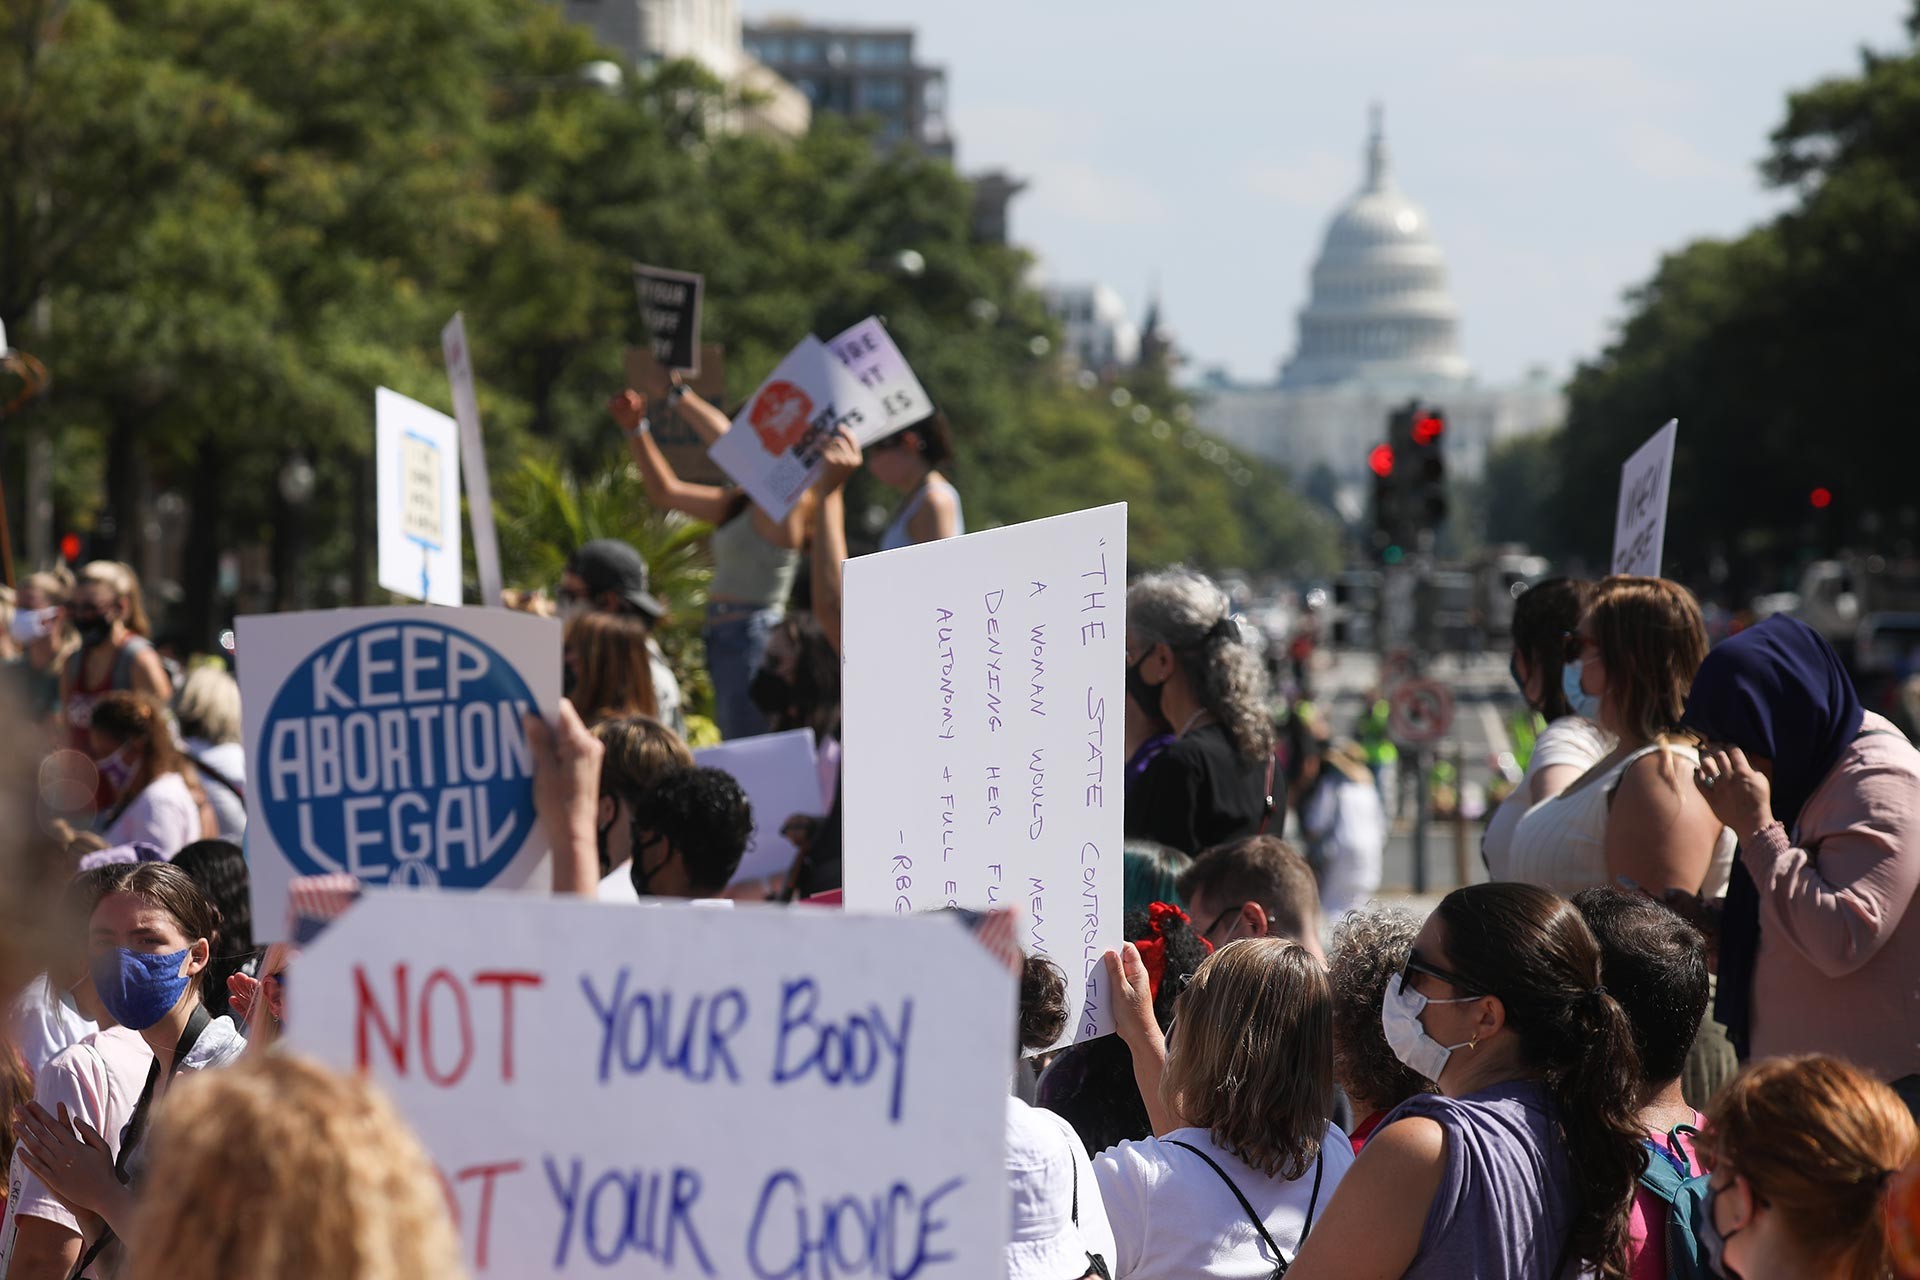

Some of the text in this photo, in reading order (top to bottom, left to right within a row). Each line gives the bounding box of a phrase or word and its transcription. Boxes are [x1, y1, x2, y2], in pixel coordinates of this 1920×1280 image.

[311, 624, 492, 711] KEEP
[935, 607, 956, 740] AUTONOMY
[984, 588, 1004, 733] DENYING
[268, 697, 536, 803] ABORTION
[985, 766, 1002, 825] HER
[1027, 580, 1048, 953] A WOMAN WOULD MEAN
[1086, 686, 1105, 808] STATE
[297, 784, 519, 879] LEGAL
[940, 793, 955, 863] FULL
[1080, 841, 1101, 1038] CONTROLLING
[350, 960, 916, 1125] NOT YOUR BODY
[541, 1152, 720, 1279] YOUR
[745, 1166, 967, 1280] CHOICE
